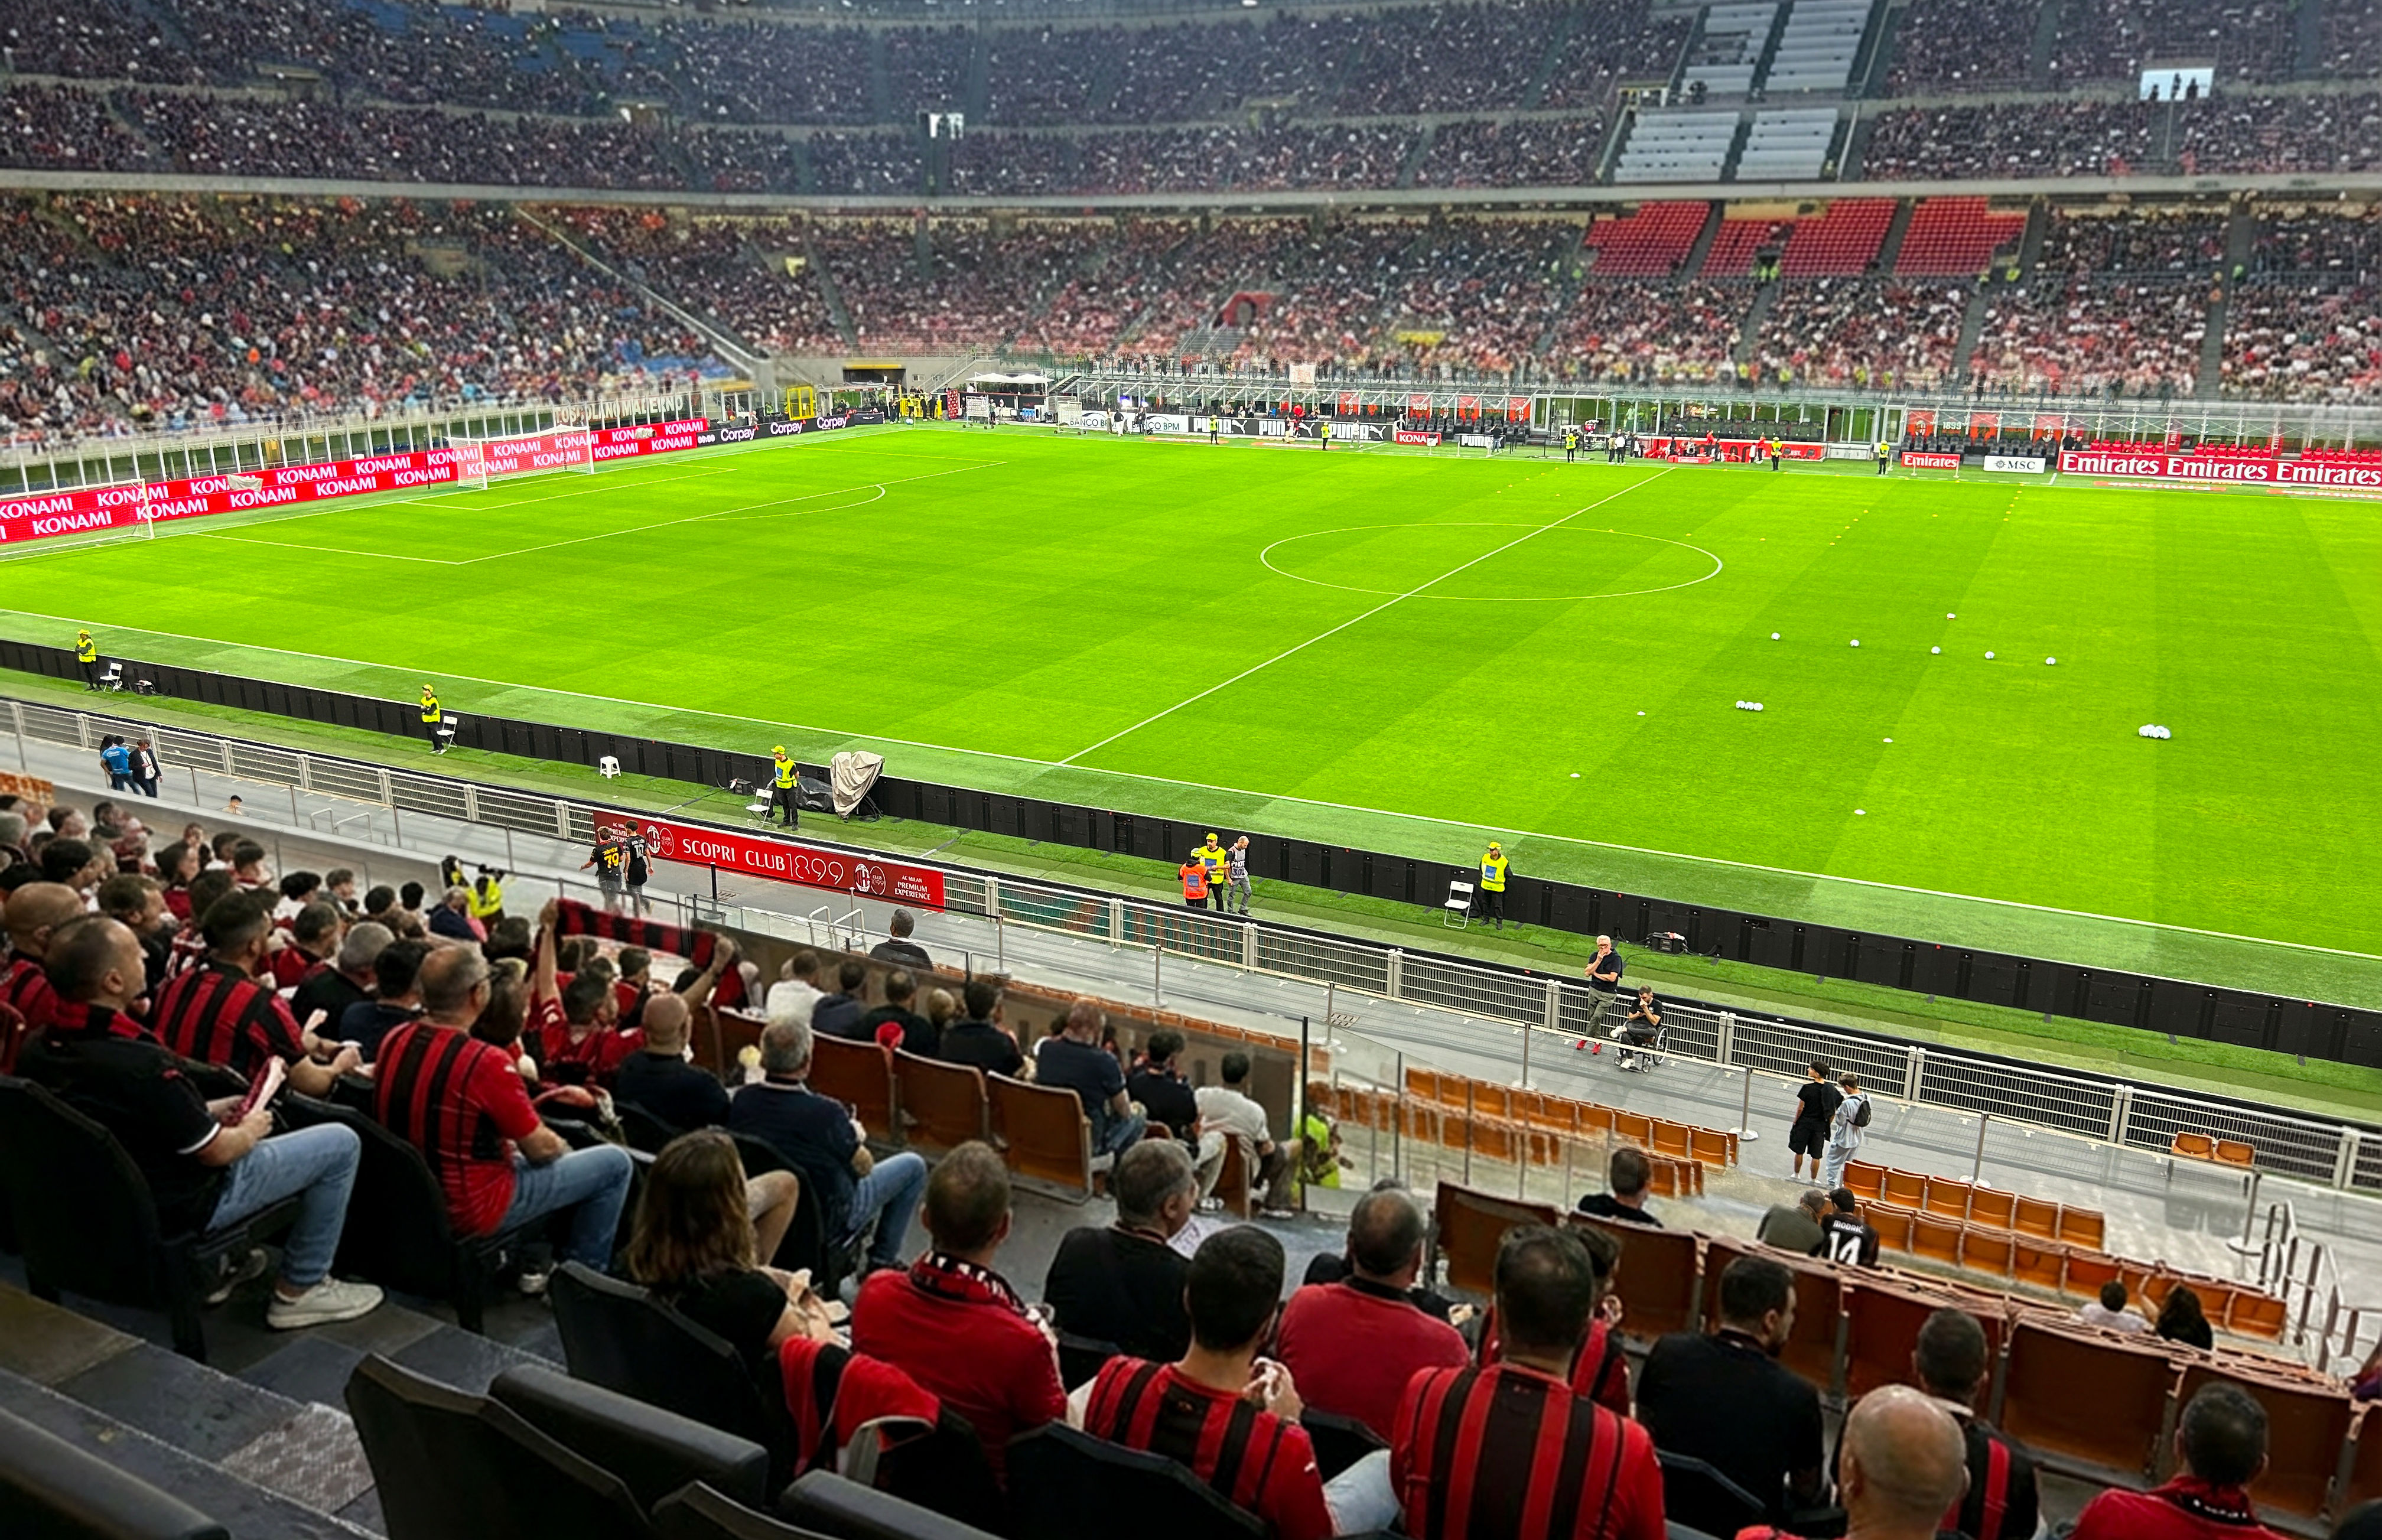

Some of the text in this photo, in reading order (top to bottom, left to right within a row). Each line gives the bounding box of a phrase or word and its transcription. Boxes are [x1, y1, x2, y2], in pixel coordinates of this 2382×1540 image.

[665, 421, 703, 435] KONAMI
[770, 422, 803, 436] Corpay
[817, 416, 847, 429] Corpay
[1070, 419, 1098, 427] BANCO
[1163, 422, 1180, 431] BPM
[1942, 422, 1962, 430] 1899
[555, 434, 599, 449] KONAMI
[612, 426, 653, 442] KON
[720, 428, 756, 442] Corpay
[493, 441, 541, 457] KONAMI
[594, 442, 639, 459] KONAMI
[652, 436, 692, 451] KONAMI
[355, 456, 411, 475] KONAMI
[428, 448, 479, 466] KONAMI
[533, 450, 580, 467] KONAMI
[1904, 455, 1958, 468] Emirates
[2008, 460, 2036, 470] MSC
[276, 465, 337, 484] KONAMI
[467, 458, 518, 476] KONAMI
[2062, 454, 2382, 486] Emirates Emirates Emirates
[395, 466, 451, 486] KONAMI
[191, 475, 256, 496] KON
[316, 476, 377, 497] KONAMI
[97, 485, 170, 507] KONAMI
[230, 487, 297, 508] KONAMI
[136, 498, 209, 520] KONAMI
[32, 510, 112, 535] KONAMI
[604, 852, 619, 869] 79
[682, 838, 844, 885] SCOPRI CLUB 1899
[894, 888, 931, 901] EXPERIENCE
[897, 881, 928, 893] PREMIUM
[1829, 1230, 1862, 1266] 14
